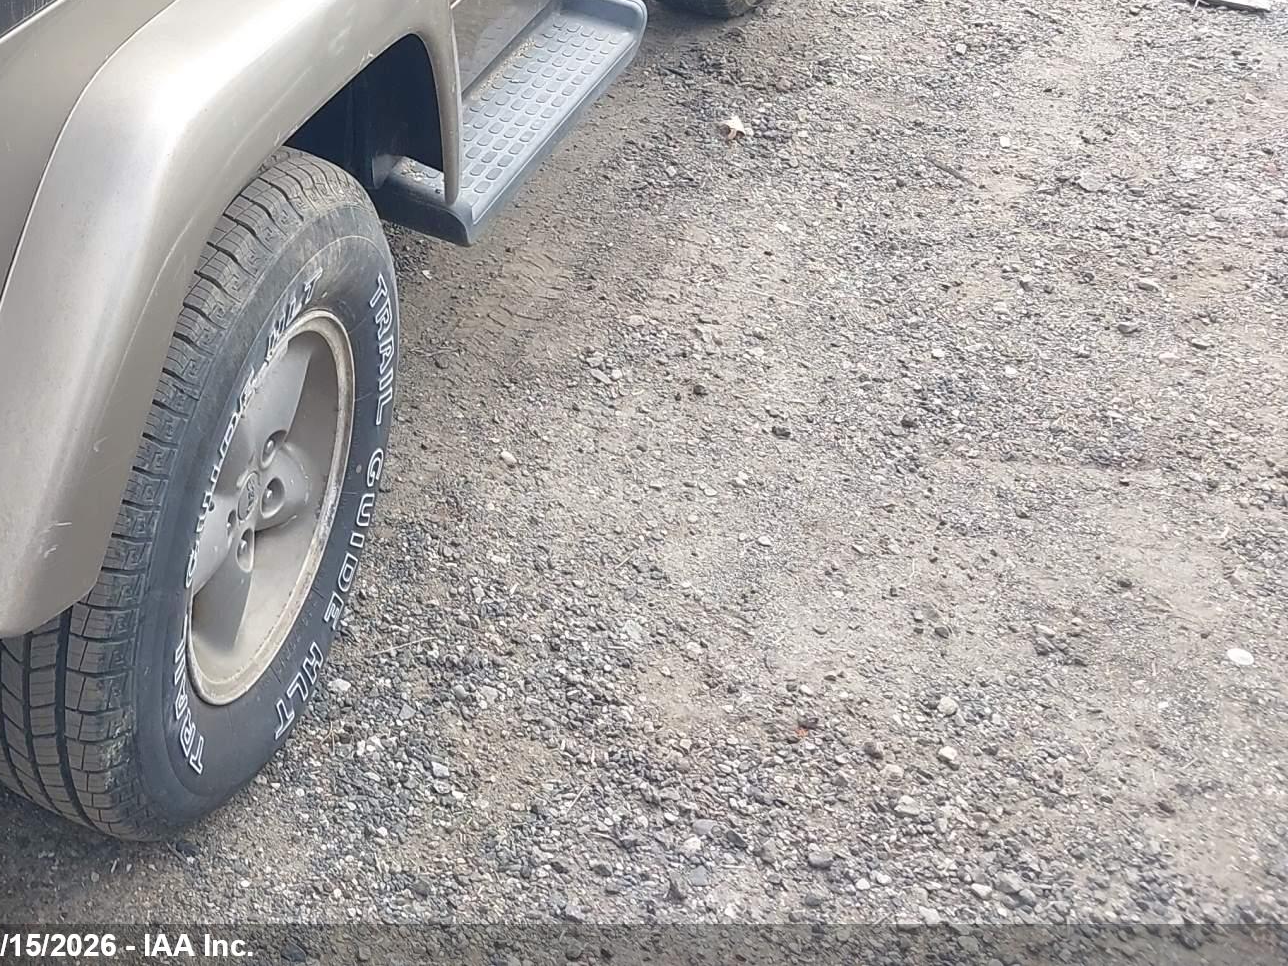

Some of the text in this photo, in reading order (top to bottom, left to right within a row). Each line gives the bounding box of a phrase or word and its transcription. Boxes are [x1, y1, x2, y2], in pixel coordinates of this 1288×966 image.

[274, 273, 395, 741] TRAIL GUIDE HLT
